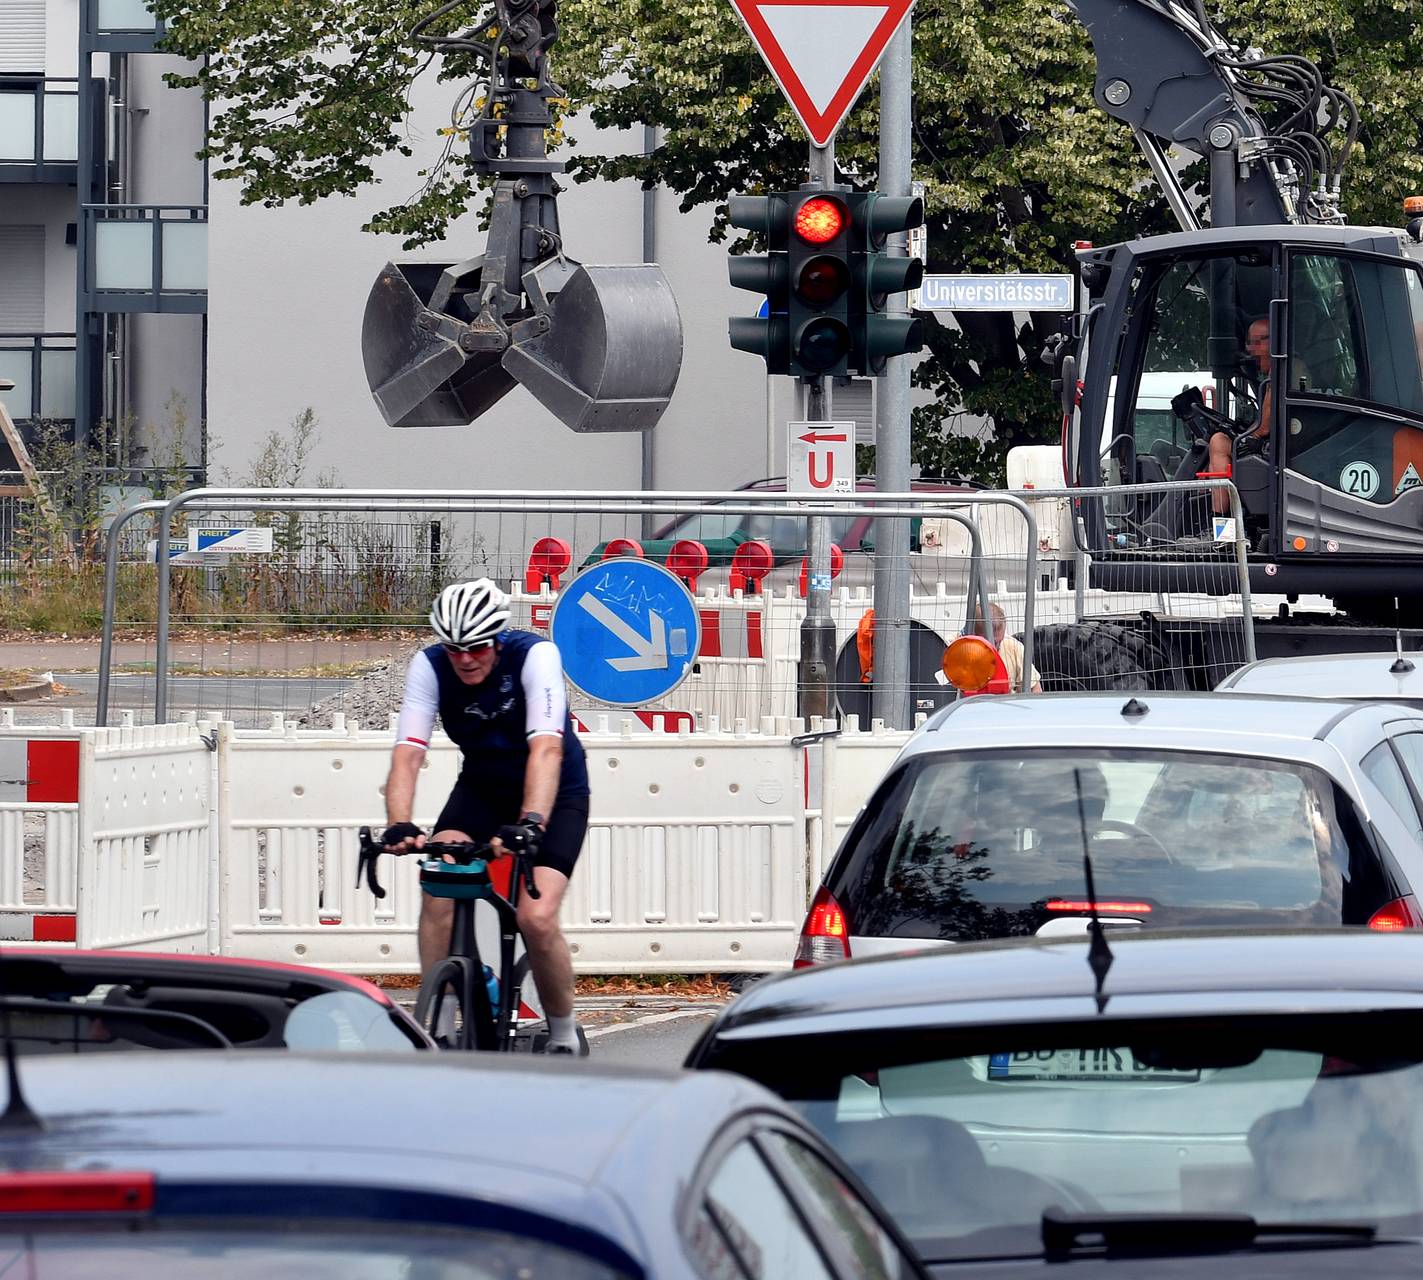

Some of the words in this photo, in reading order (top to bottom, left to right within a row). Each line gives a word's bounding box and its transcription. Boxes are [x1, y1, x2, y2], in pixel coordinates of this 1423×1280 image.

[926, 280, 1063, 302] Universitätsstr.
[809, 452, 833, 488] U
[1348, 469, 1371, 493] 20
